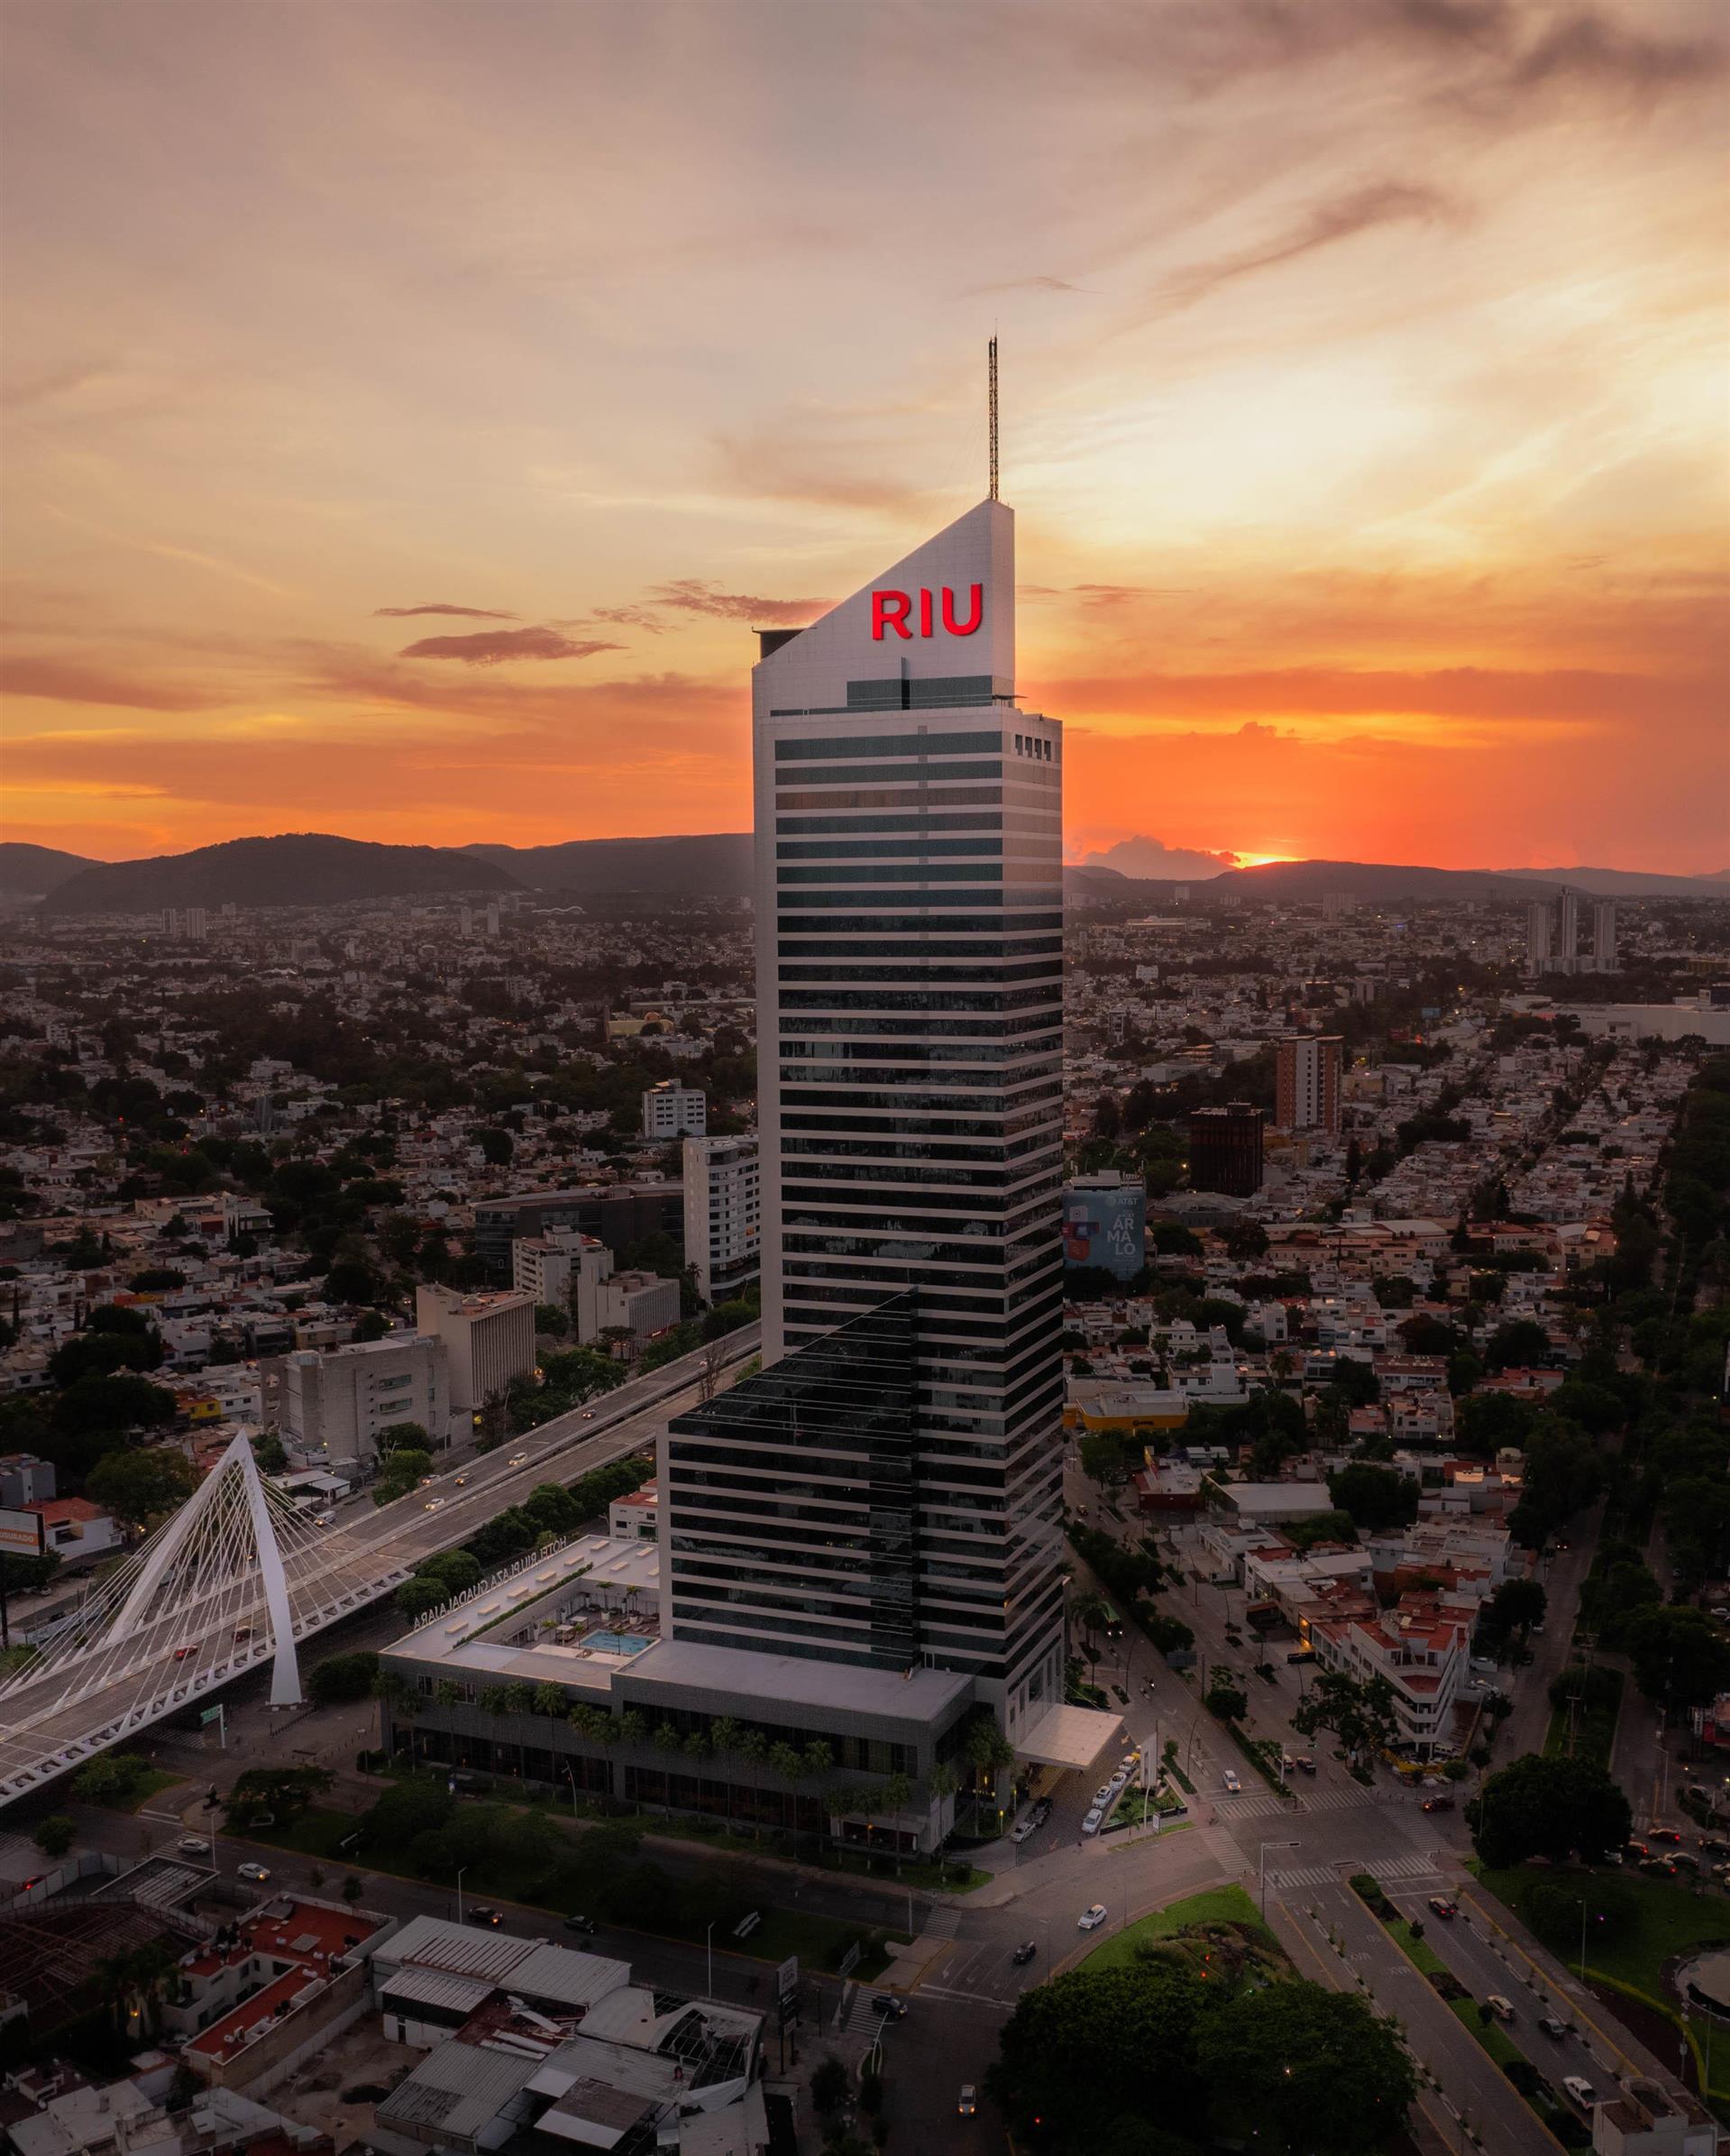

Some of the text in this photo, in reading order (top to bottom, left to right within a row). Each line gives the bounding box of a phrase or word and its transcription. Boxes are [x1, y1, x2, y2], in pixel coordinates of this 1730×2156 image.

[872, 583, 983, 640] RIU
[1114, 1218, 1134, 1230] AR
[1108, 1231, 1130, 1242] MA
[1116, 1243, 1136, 1254] LO
